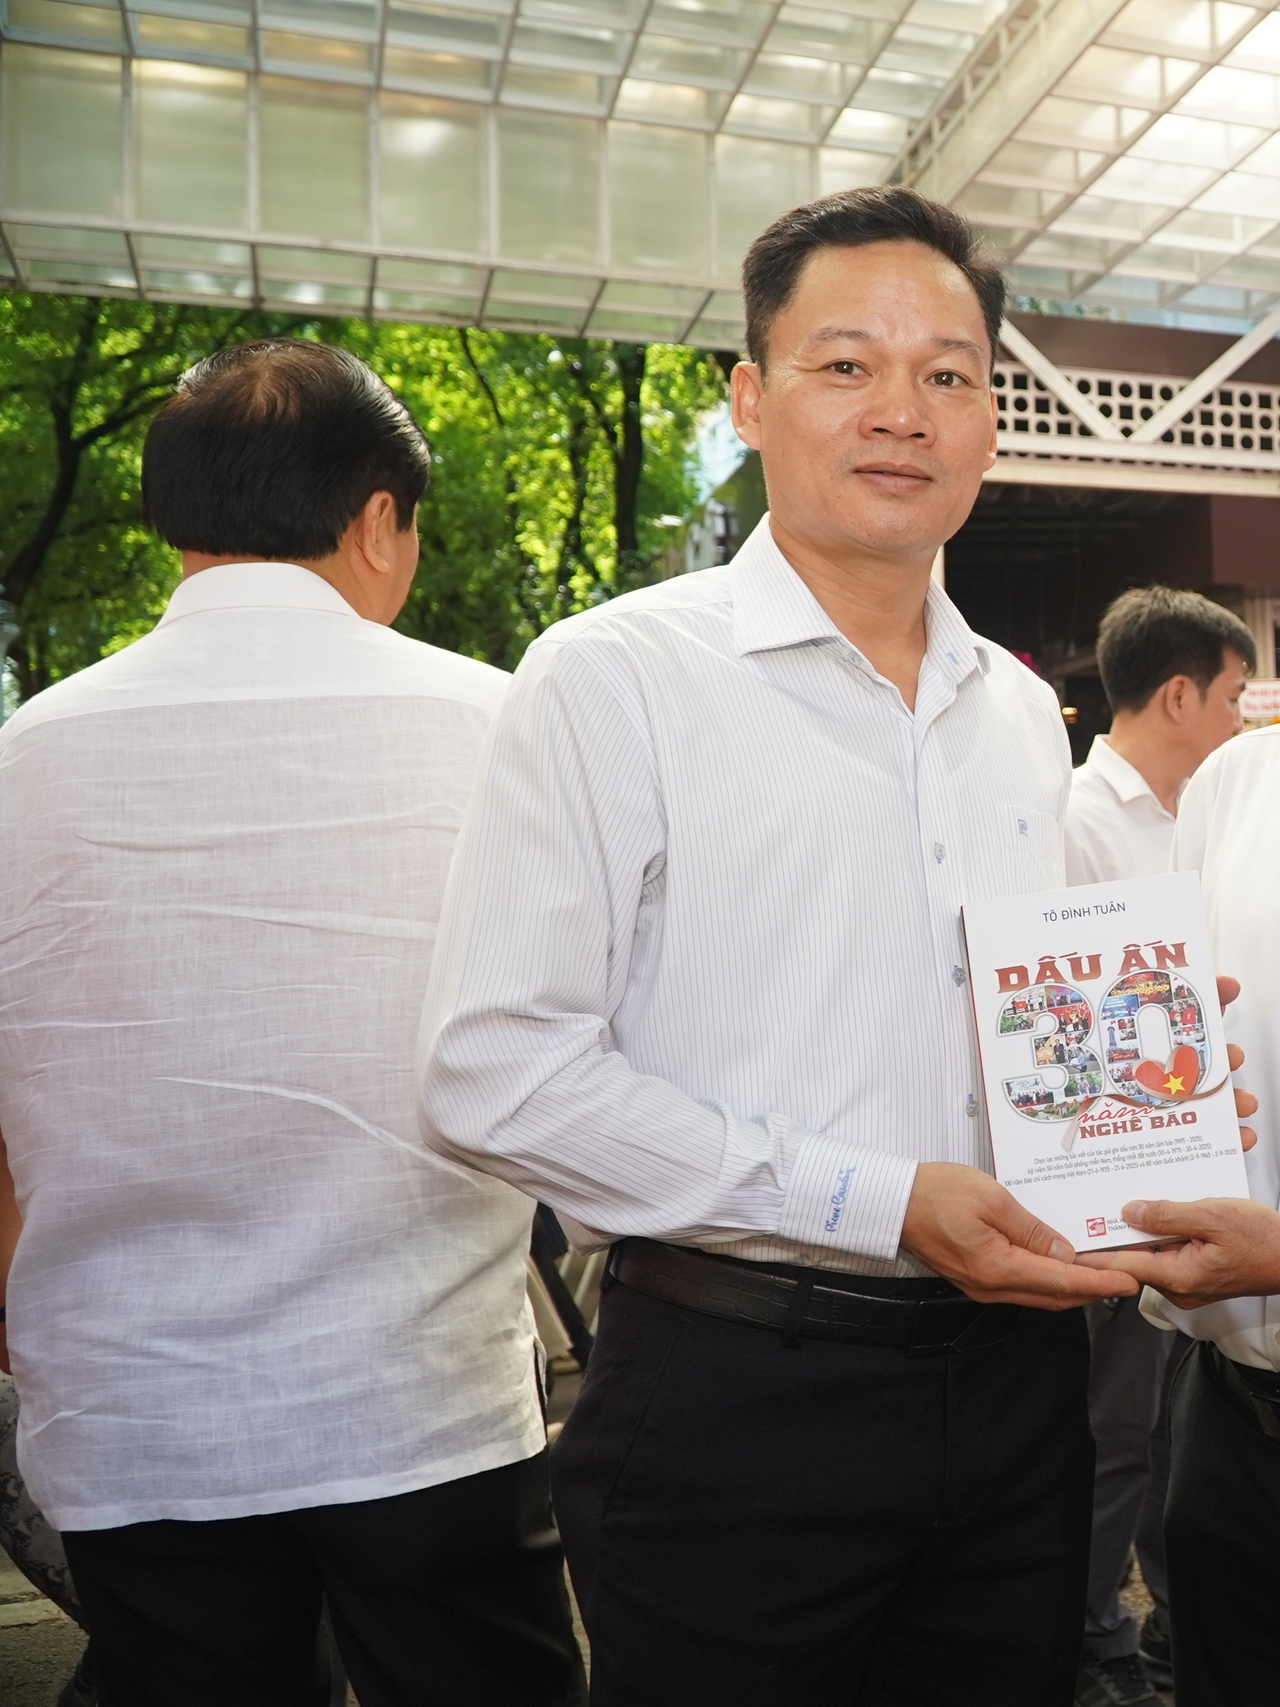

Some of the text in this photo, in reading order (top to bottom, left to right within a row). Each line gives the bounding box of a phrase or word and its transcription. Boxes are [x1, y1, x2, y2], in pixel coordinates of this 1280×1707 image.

[1042, 901, 1126, 923] TÔ ĐÌNH TUÂN
[994, 939, 1190, 995] DẤU ẤN
[996, 968, 1213, 1124] 30
[1077, 1102, 1155, 1124] năm
[1079, 1111, 1198, 1139] NGHỀ BÁO
